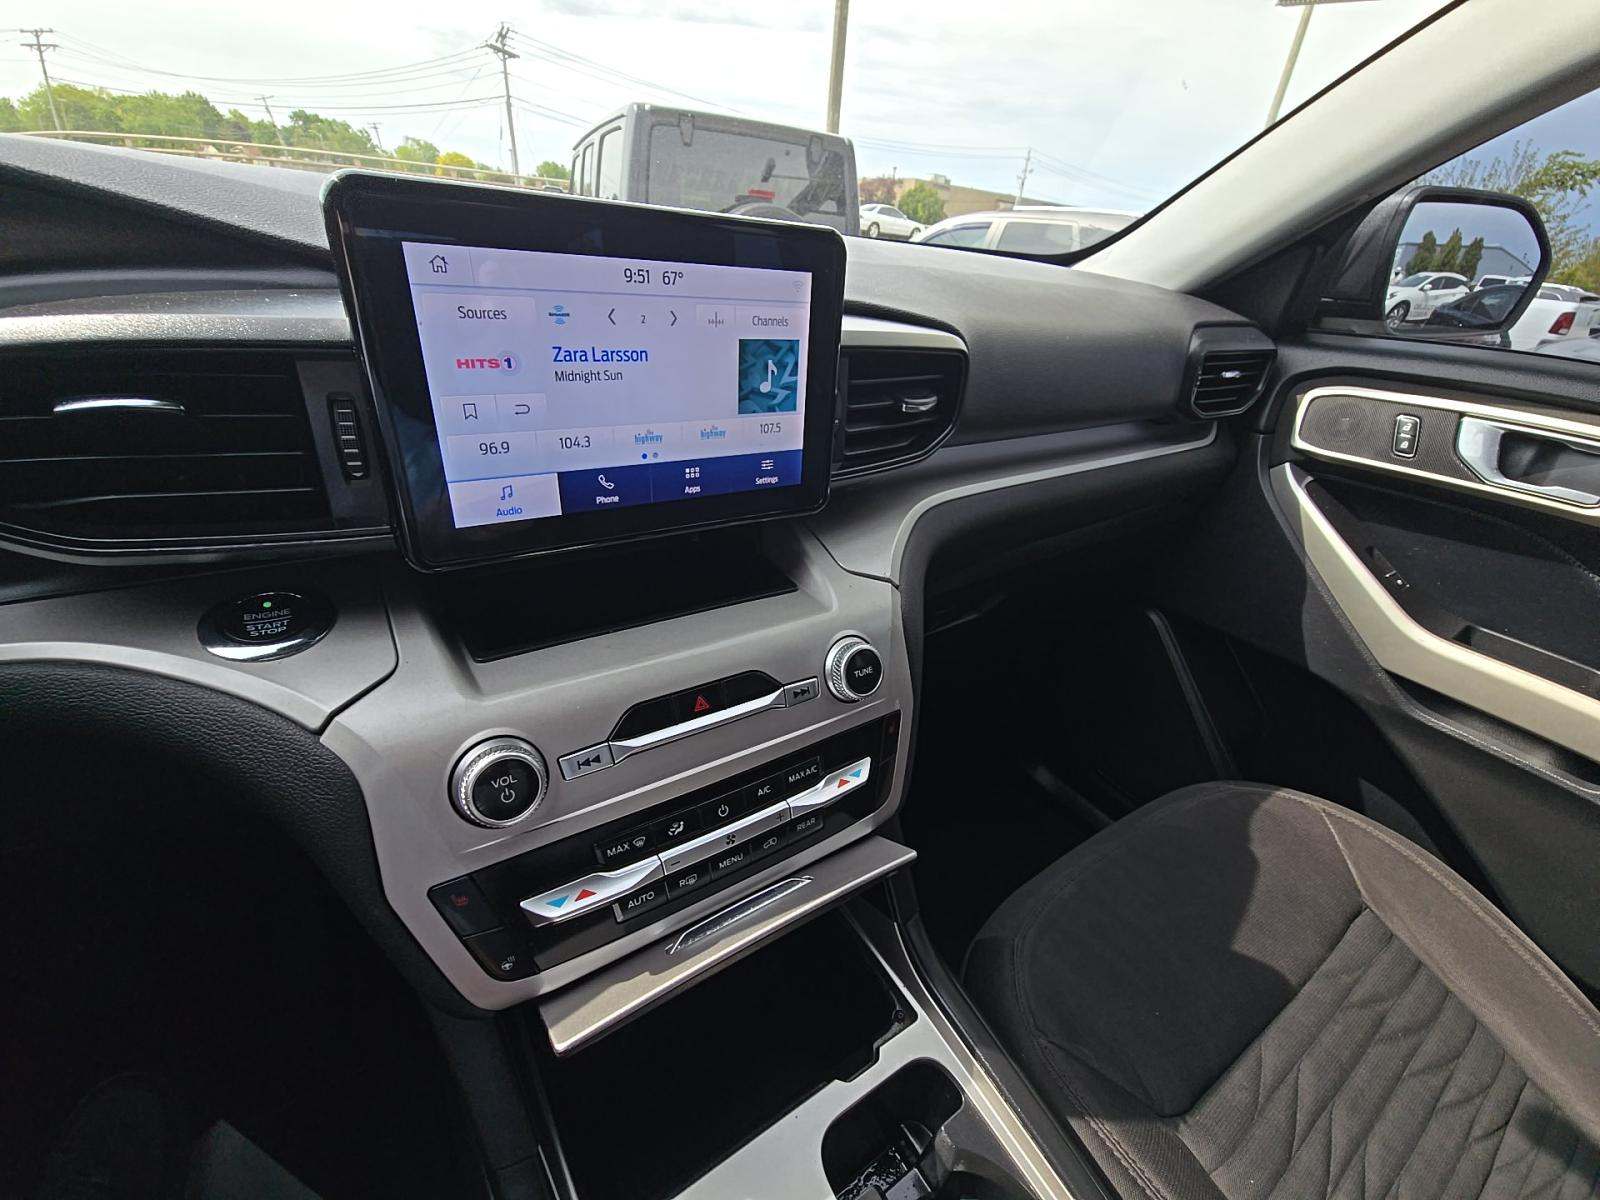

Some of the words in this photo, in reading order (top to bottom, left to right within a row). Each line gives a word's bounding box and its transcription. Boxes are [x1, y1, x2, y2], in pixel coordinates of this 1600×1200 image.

[623, 267, 650, 284] 9:51
[662, 270, 684, 286] 67°
[457, 305, 508, 321] Sources
[640, 314, 647, 324] 2
[751, 315, 790, 328] Channels
[552, 345, 589, 363] Zara
[591, 346, 649, 363] Larsson
[456, 358, 500, 369] HITS
[554, 370, 602, 384] Midnight
[603, 369, 624, 381] Sun
[759, 422, 782, 435] 107.5
[478, 441, 511, 456] 96.9
[558, 435, 592, 450] 104.3
[755, 475, 779, 487] Settings
[684, 485, 701, 495] Apps
[596, 495, 620, 505] Phone
[496, 506, 523, 518] Audio
[243, 608, 291, 620] ENGINE
[246, 620, 290, 631] START
[249, 626, 287, 637] STOP
[853, 665, 874, 678] TUNE
[788, 772, 806, 784] MAX
[805, 764, 818, 777] A/C
[490, 774, 518, 788] VOL
[757, 784, 772, 797] A/C
[796, 817, 817, 832] REAR
[606, 842, 631, 858] MAX
[718, 853, 744, 869] MENU
[626, 891, 656, 910] AUTO
